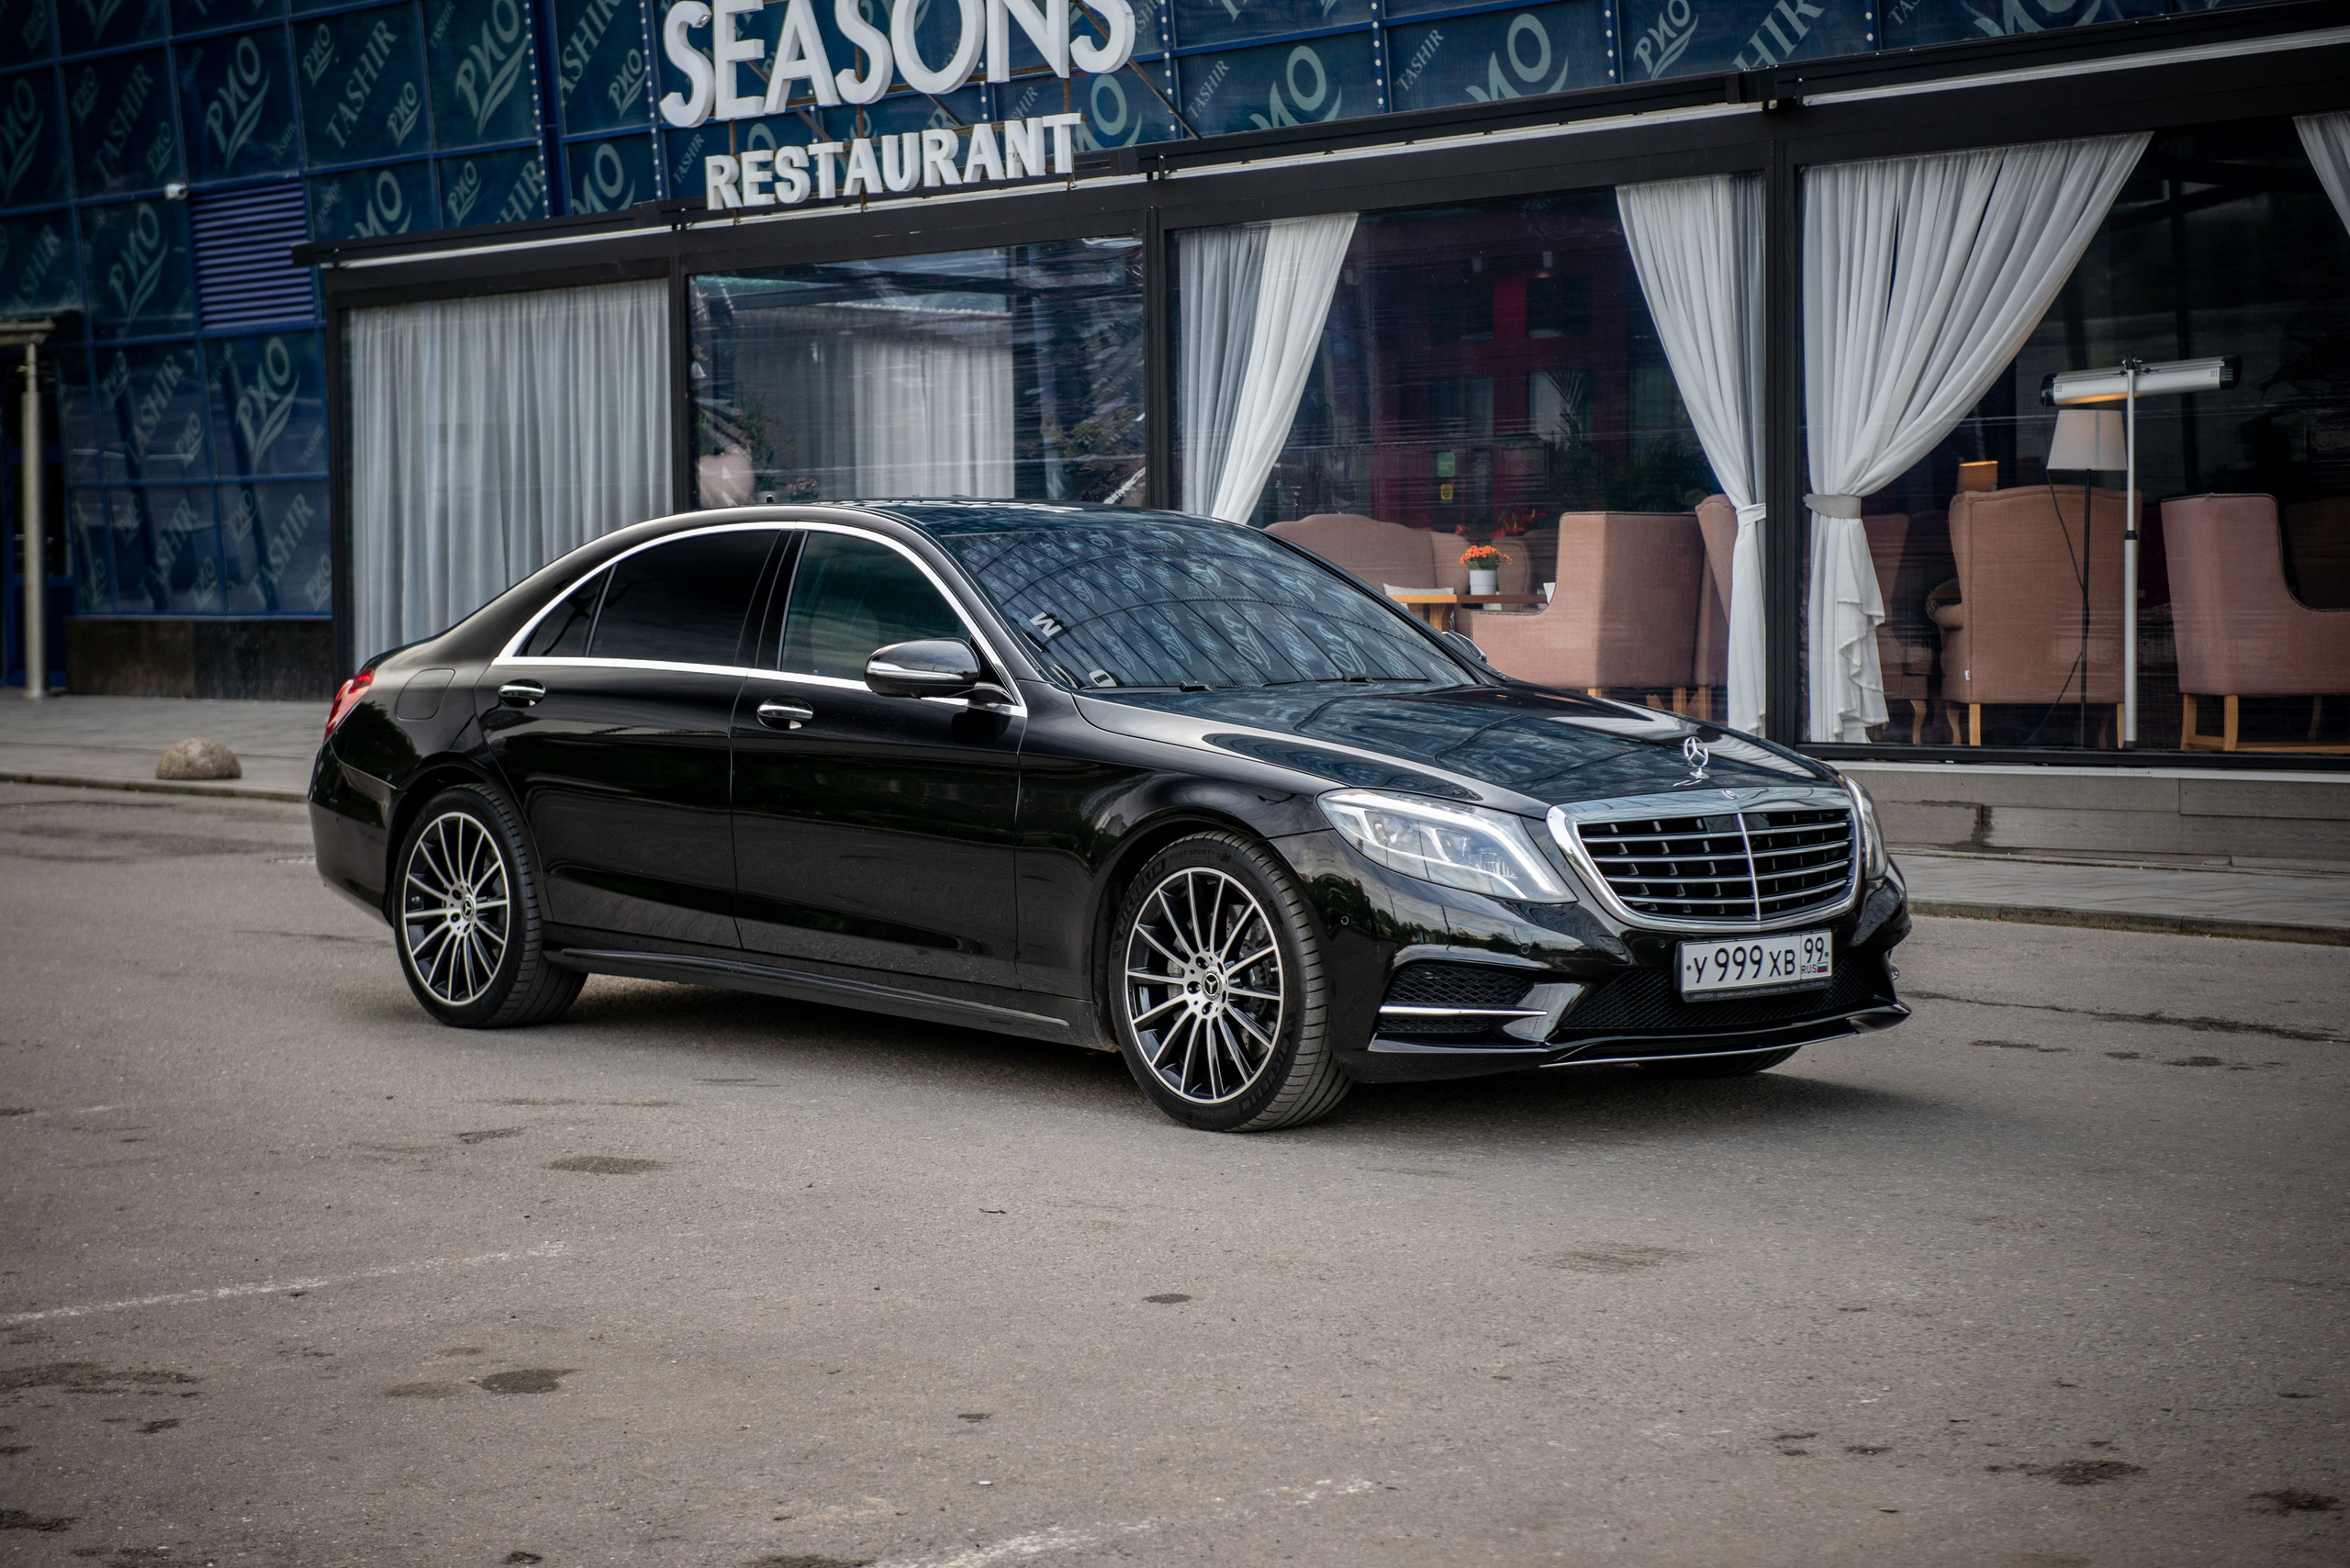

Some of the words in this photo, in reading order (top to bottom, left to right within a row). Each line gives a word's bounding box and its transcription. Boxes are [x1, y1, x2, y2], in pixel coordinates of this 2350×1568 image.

[324, 19, 398, 150] TASHIR
[659, 0, 1136, 129] SEASONS
[1188, 60, 1230, 120] TASHIR
[1396, 28, 1445, 91] TASHIR
[673, 134, 705, 184] TASHIR
[704, 113, 1081, 210] RESTAURANT
[1801, 965, 1818, 974] RUS
[1804, 936, 1825, 964] 99
